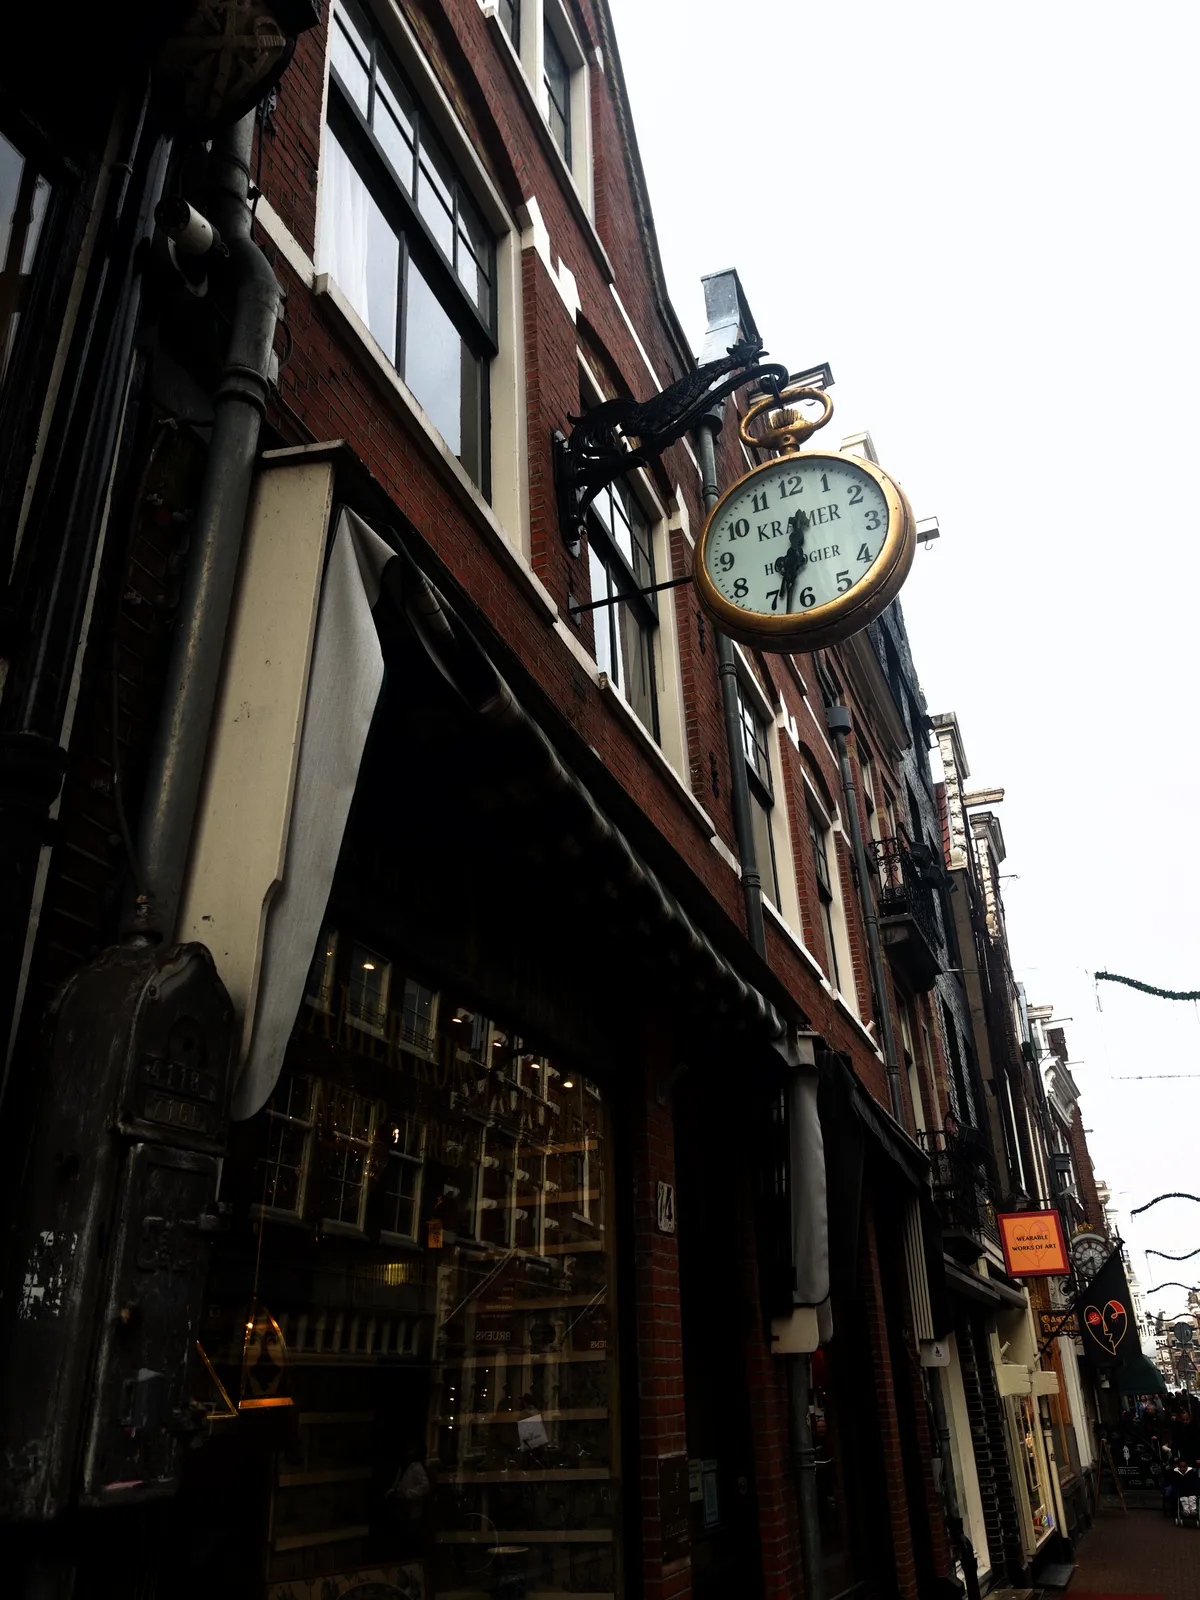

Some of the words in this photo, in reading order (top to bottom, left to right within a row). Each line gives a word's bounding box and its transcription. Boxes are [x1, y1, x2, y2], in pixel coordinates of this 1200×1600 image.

[778, 476, 804, 499] 12
[820, 473, 831, 493] 1
[751, 491, 770, 514] 11
[847, 485, 864, 506] 2
[727, 518, 750, 542] 10
[864, 510, 881, 531] 3
[720, 552, 735, 572] 9
[764, 545, 841, 576] HOGIER
[856, 543, 873, 564] 4
[733, 578, 749, 598] 8
[836, 570, 853, 592] 5
[766, 590, 780, 611] 7
[800, 586, 816, 608] 6
[1016, 1234, 1048, 1242] WEARABLE
